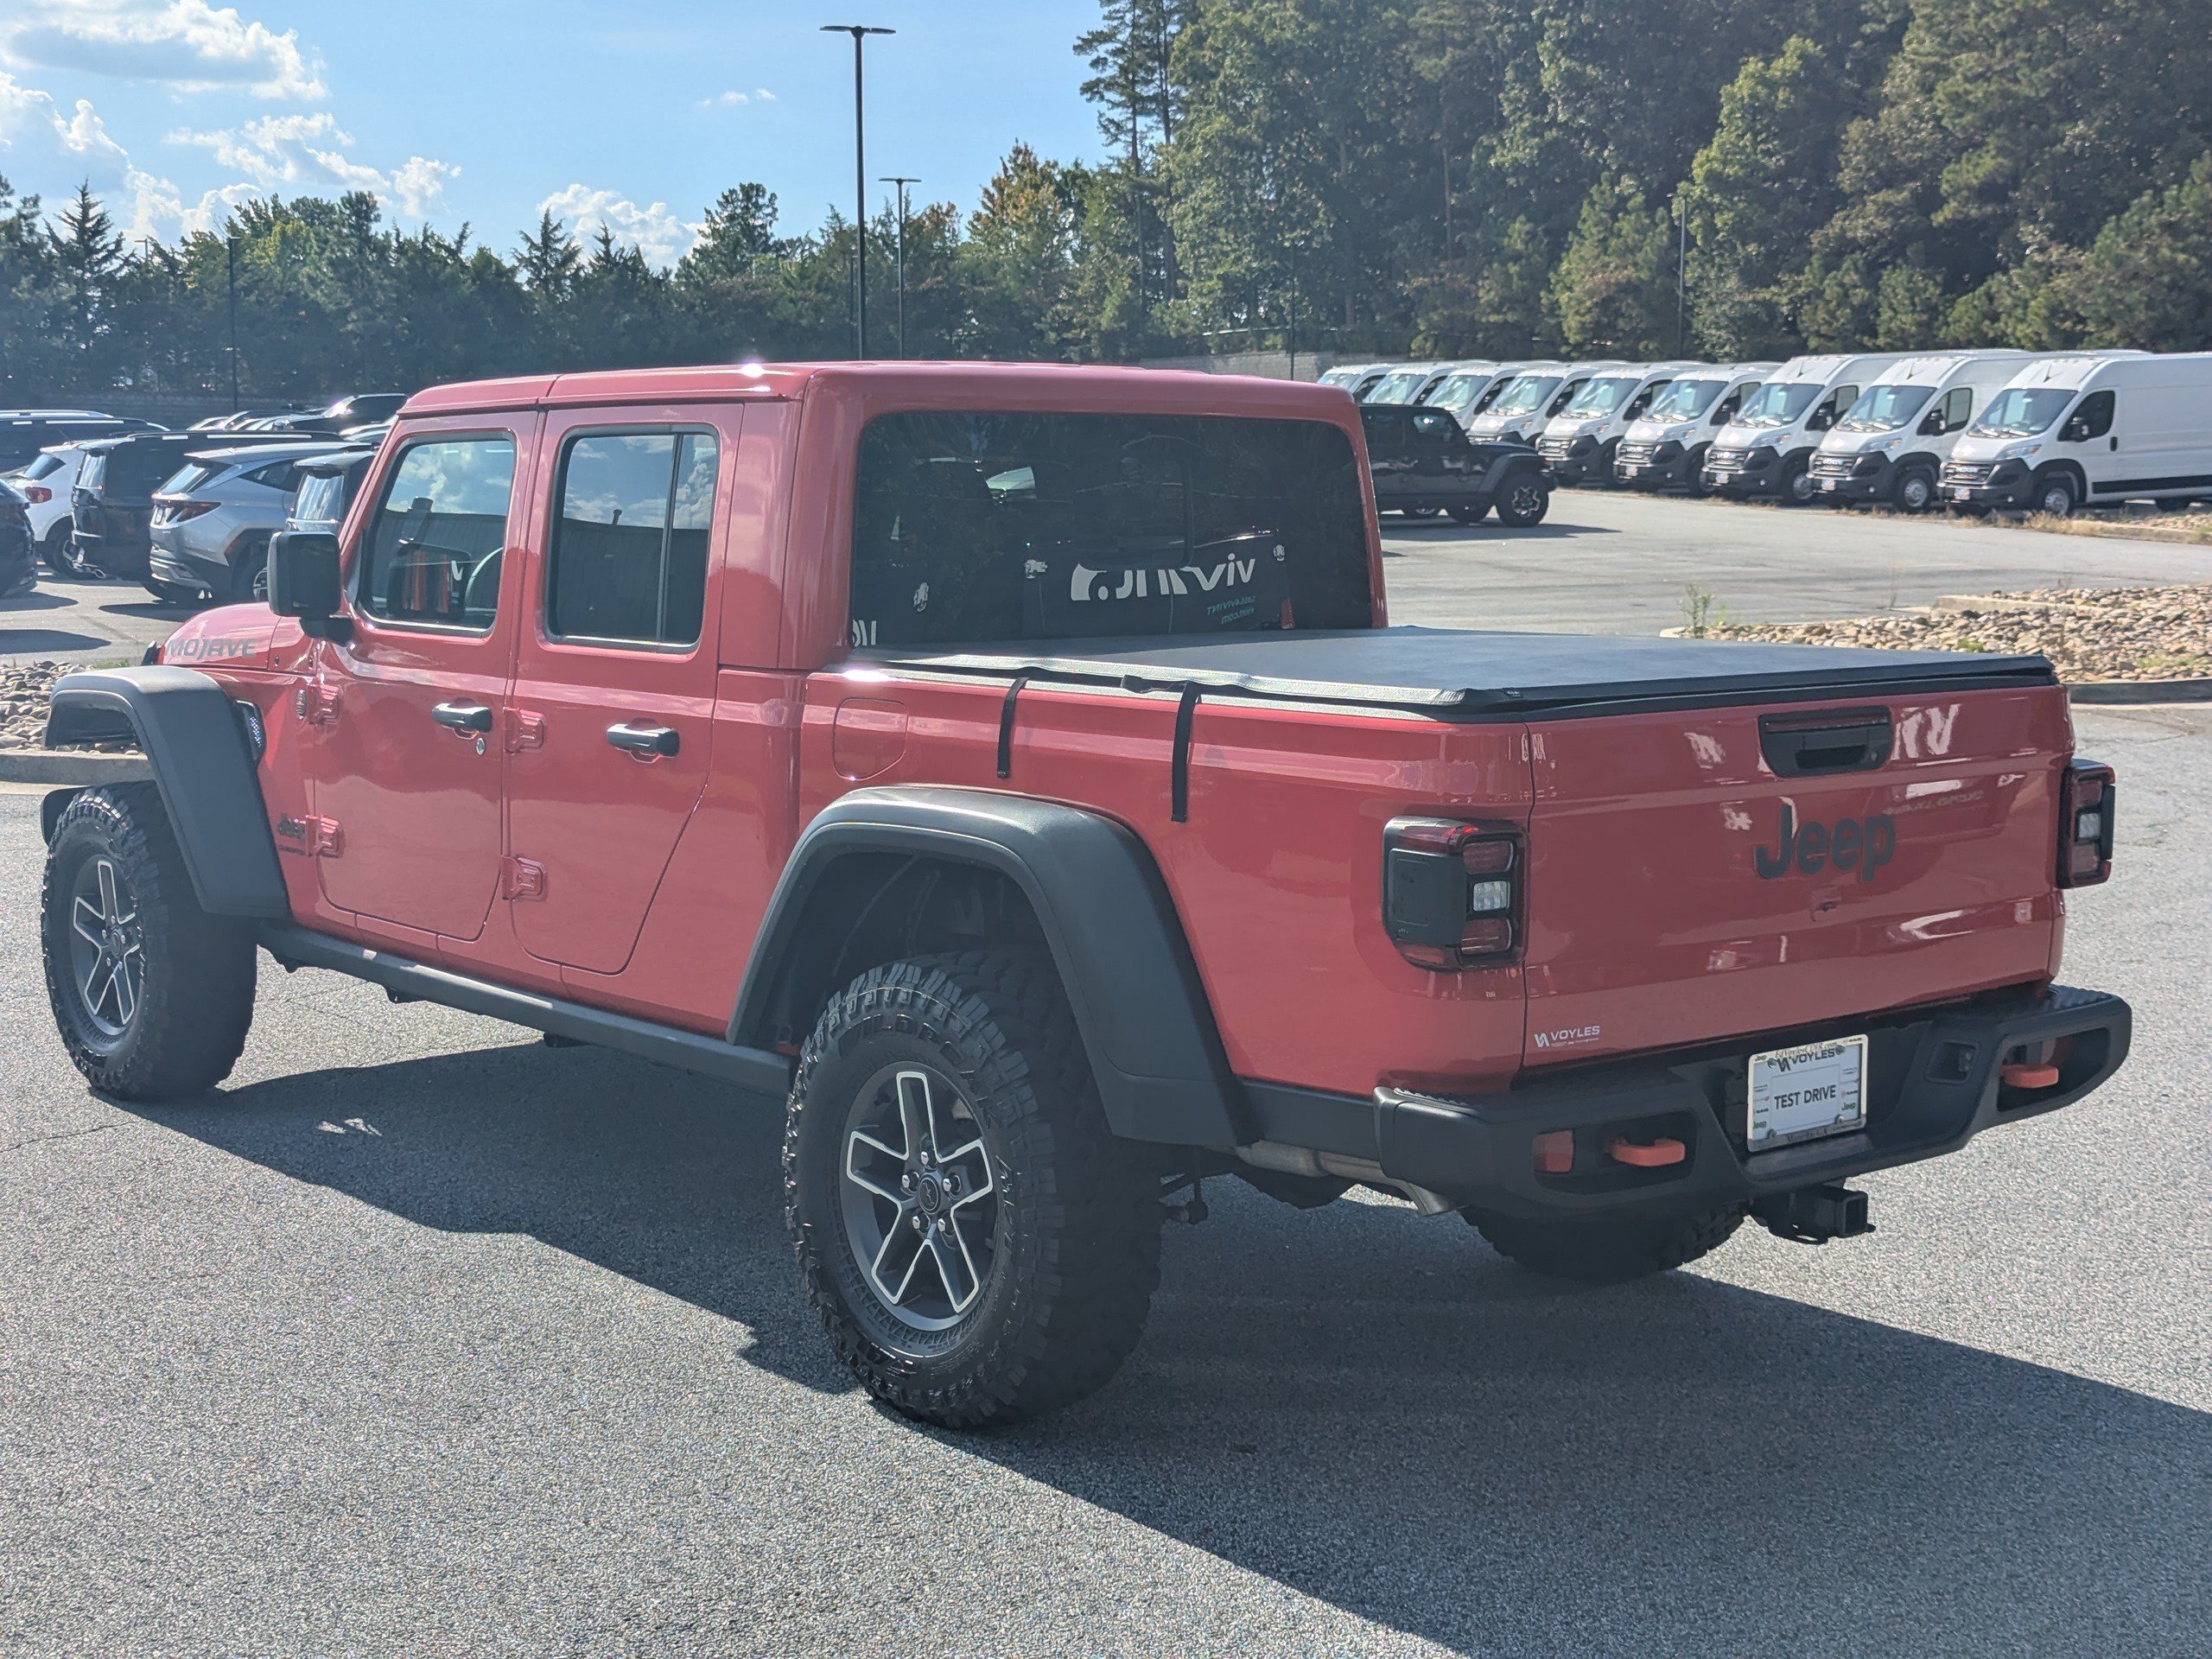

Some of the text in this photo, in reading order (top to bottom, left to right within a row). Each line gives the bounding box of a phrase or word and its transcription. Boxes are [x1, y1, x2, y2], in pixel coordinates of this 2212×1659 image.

[164, 639, 257, 660] MOJAVE
[1754, 804, 1896, 883] Jeep
[1551, 1025, 1601, 1041] VOYLES
[1792, 1048, 1836, 1065] VOYLES
[1774, 1084, 1837, 1110] TEST DRIVE
[1841, 1102, 1856, 1112] Jeep
